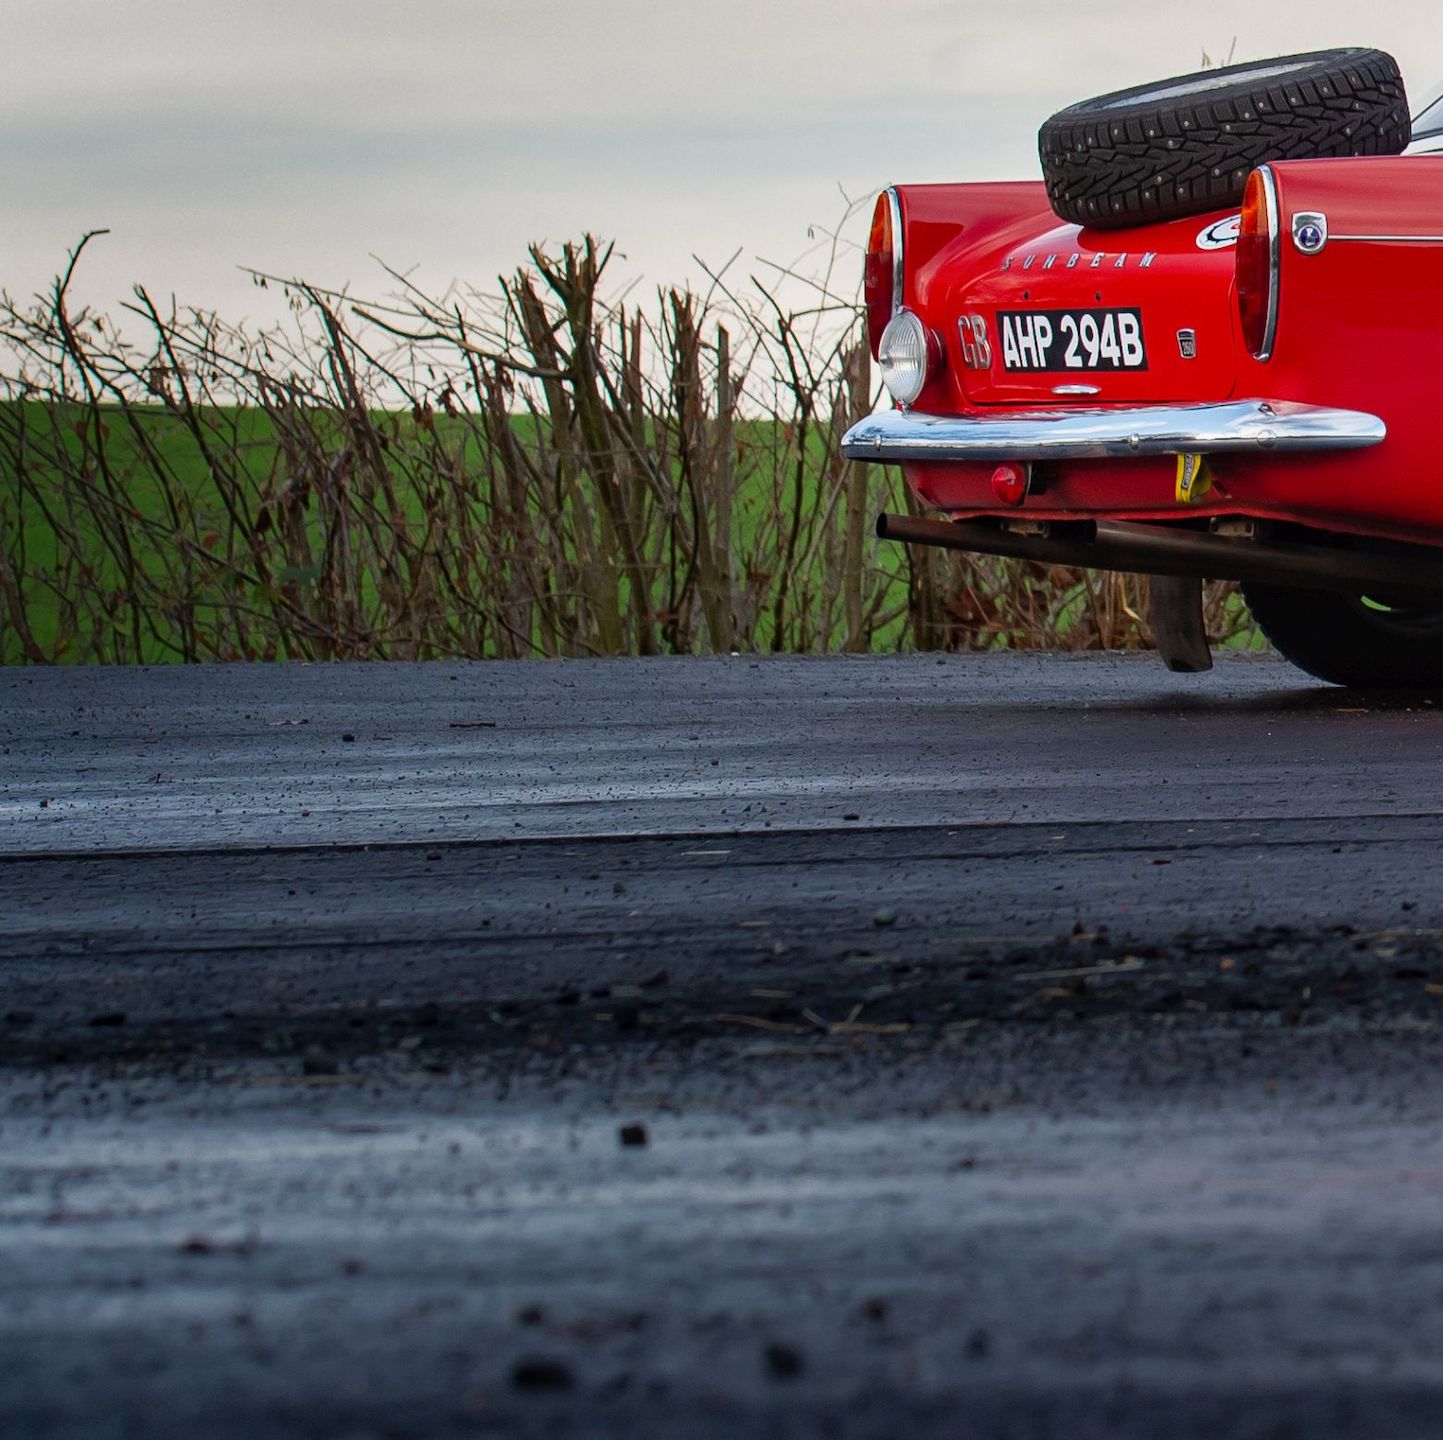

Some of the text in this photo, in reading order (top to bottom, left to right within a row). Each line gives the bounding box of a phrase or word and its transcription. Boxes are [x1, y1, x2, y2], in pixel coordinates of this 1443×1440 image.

[1001, 252, 1158, 270] SUNBEAM
[958, 313, 991, 369] GB
[1002, 312, 1144, 368] AHP 294B
